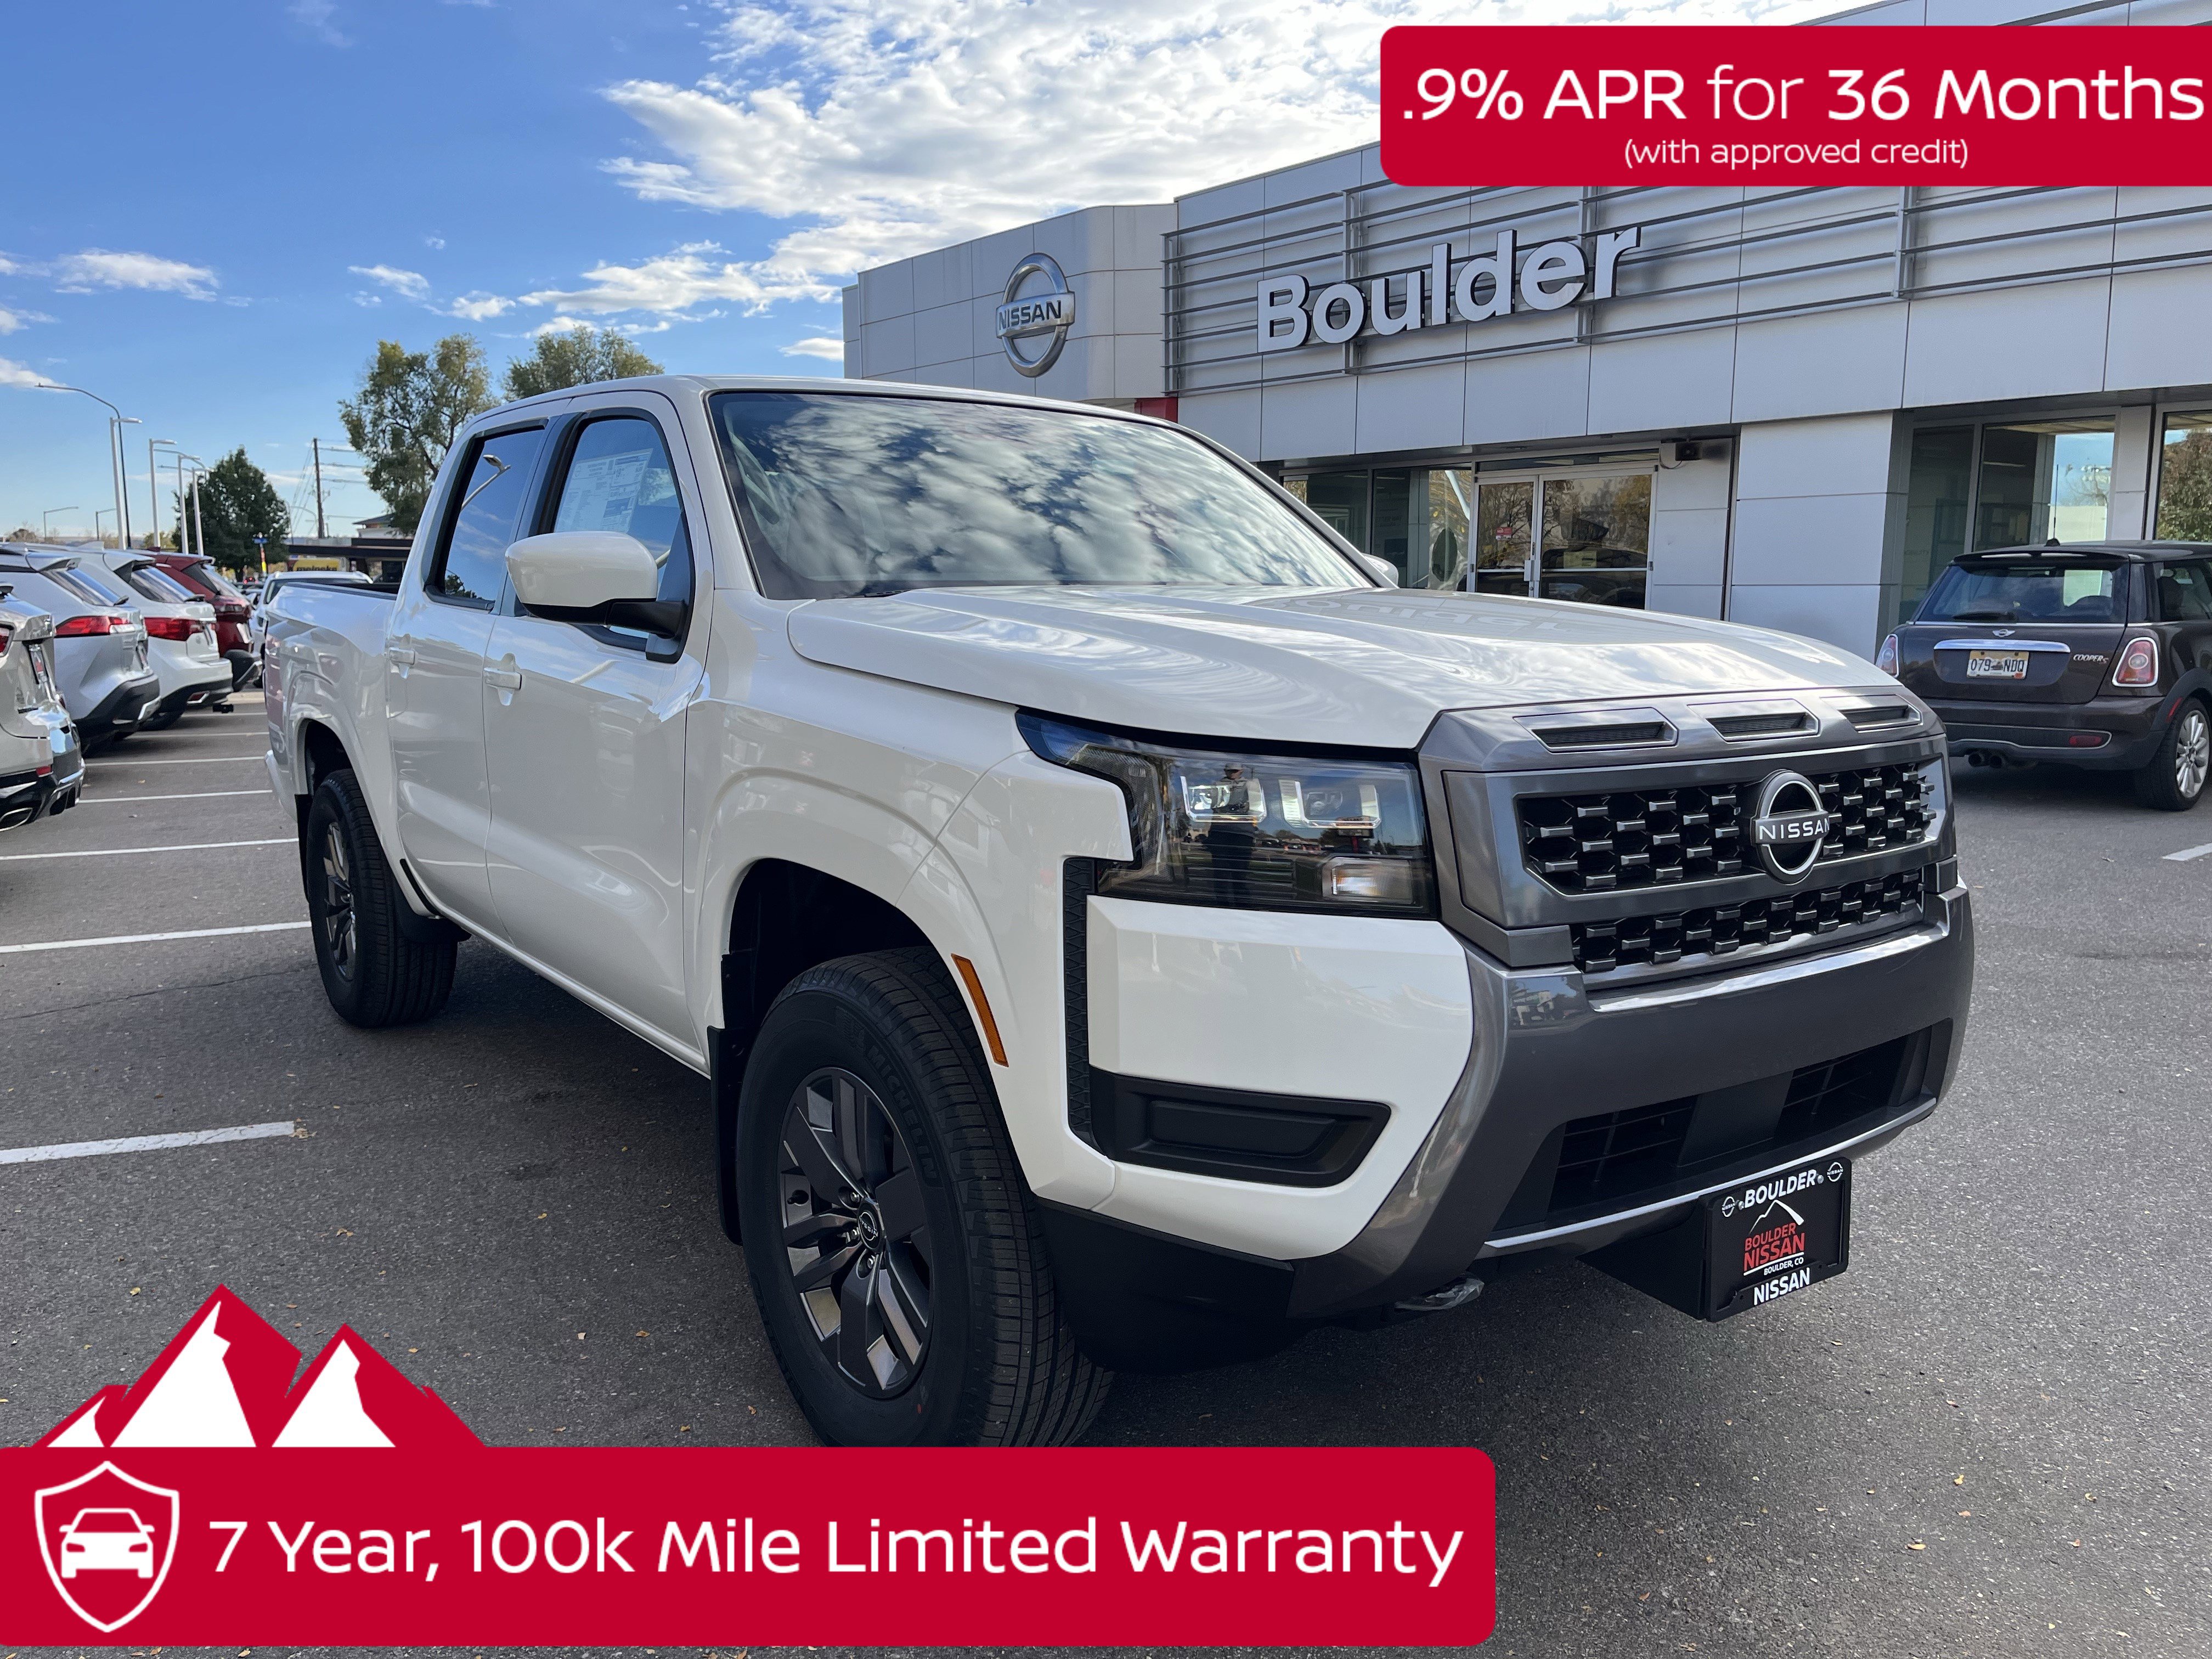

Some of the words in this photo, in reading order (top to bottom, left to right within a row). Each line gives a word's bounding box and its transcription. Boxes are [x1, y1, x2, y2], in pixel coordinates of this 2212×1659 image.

[1257, 226, 1641, 353] Boulder
[999, 300, 1062, 330] NISSAN
[1971, 659, 1991, 671] 079
[1759, 818, 1830, 840] NISSAN
[866, 1045, 938, 1183] MICHELIN
[1743, 1170, 1817, 1208] BOULDER
[1743, 1233, 1805, 1272] NISSAN
[1745, 1222, 1796, 1251] BOULDER
[1764, 1260, 1793, 1276] BOULDER,
[1795, 1257, 1804, 1265] CO
[1754, 1267, 1810, 1305] NISSAN
